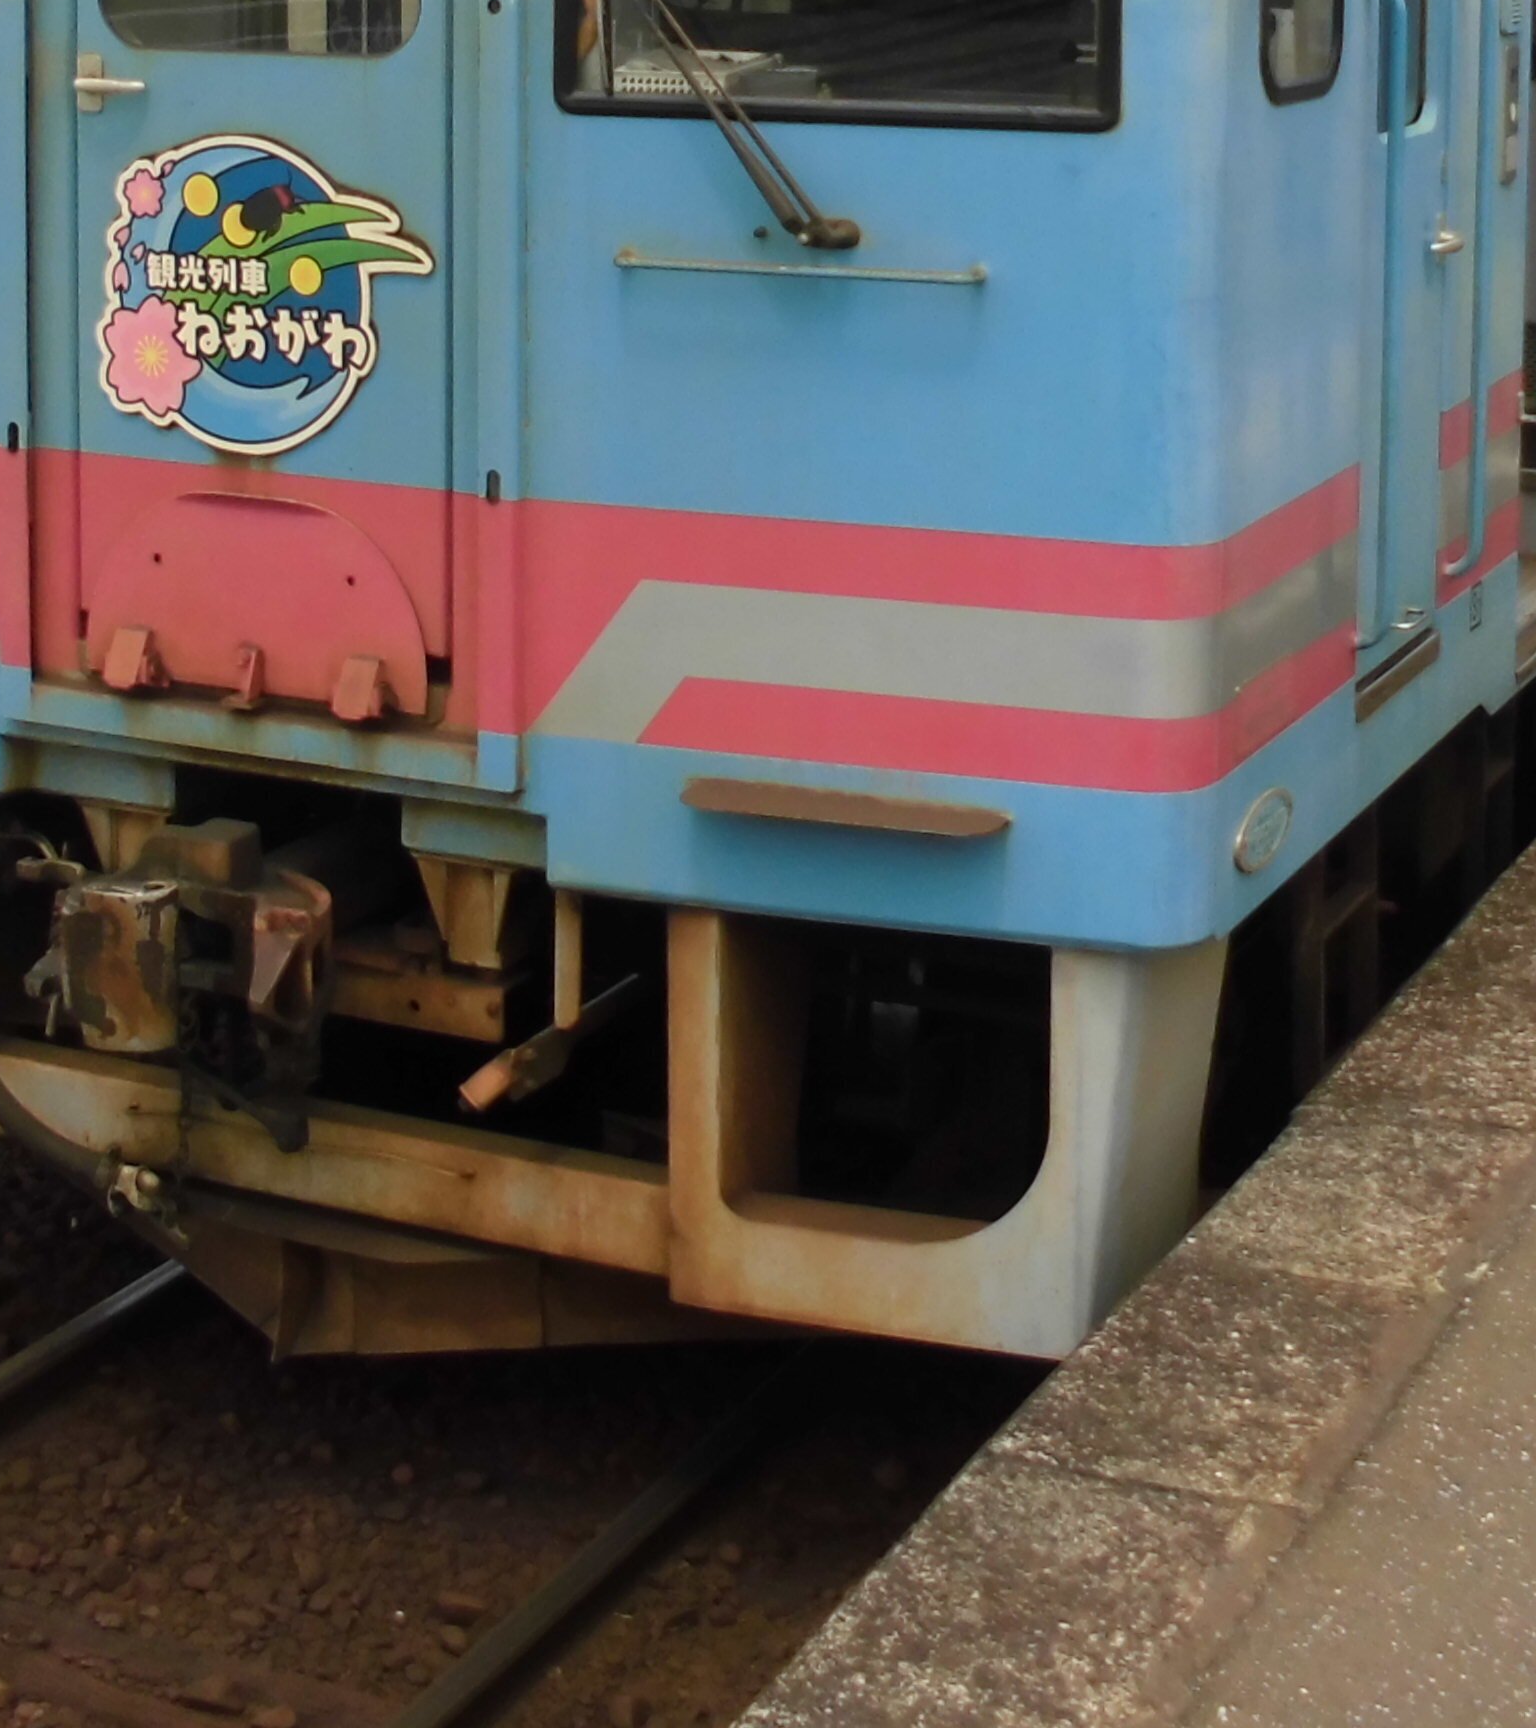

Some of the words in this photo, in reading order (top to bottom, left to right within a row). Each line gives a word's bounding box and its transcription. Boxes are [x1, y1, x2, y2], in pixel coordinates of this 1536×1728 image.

[146, 251, 269, 295] 観光列車
[174, 302, 366, 370] ねおがわ
